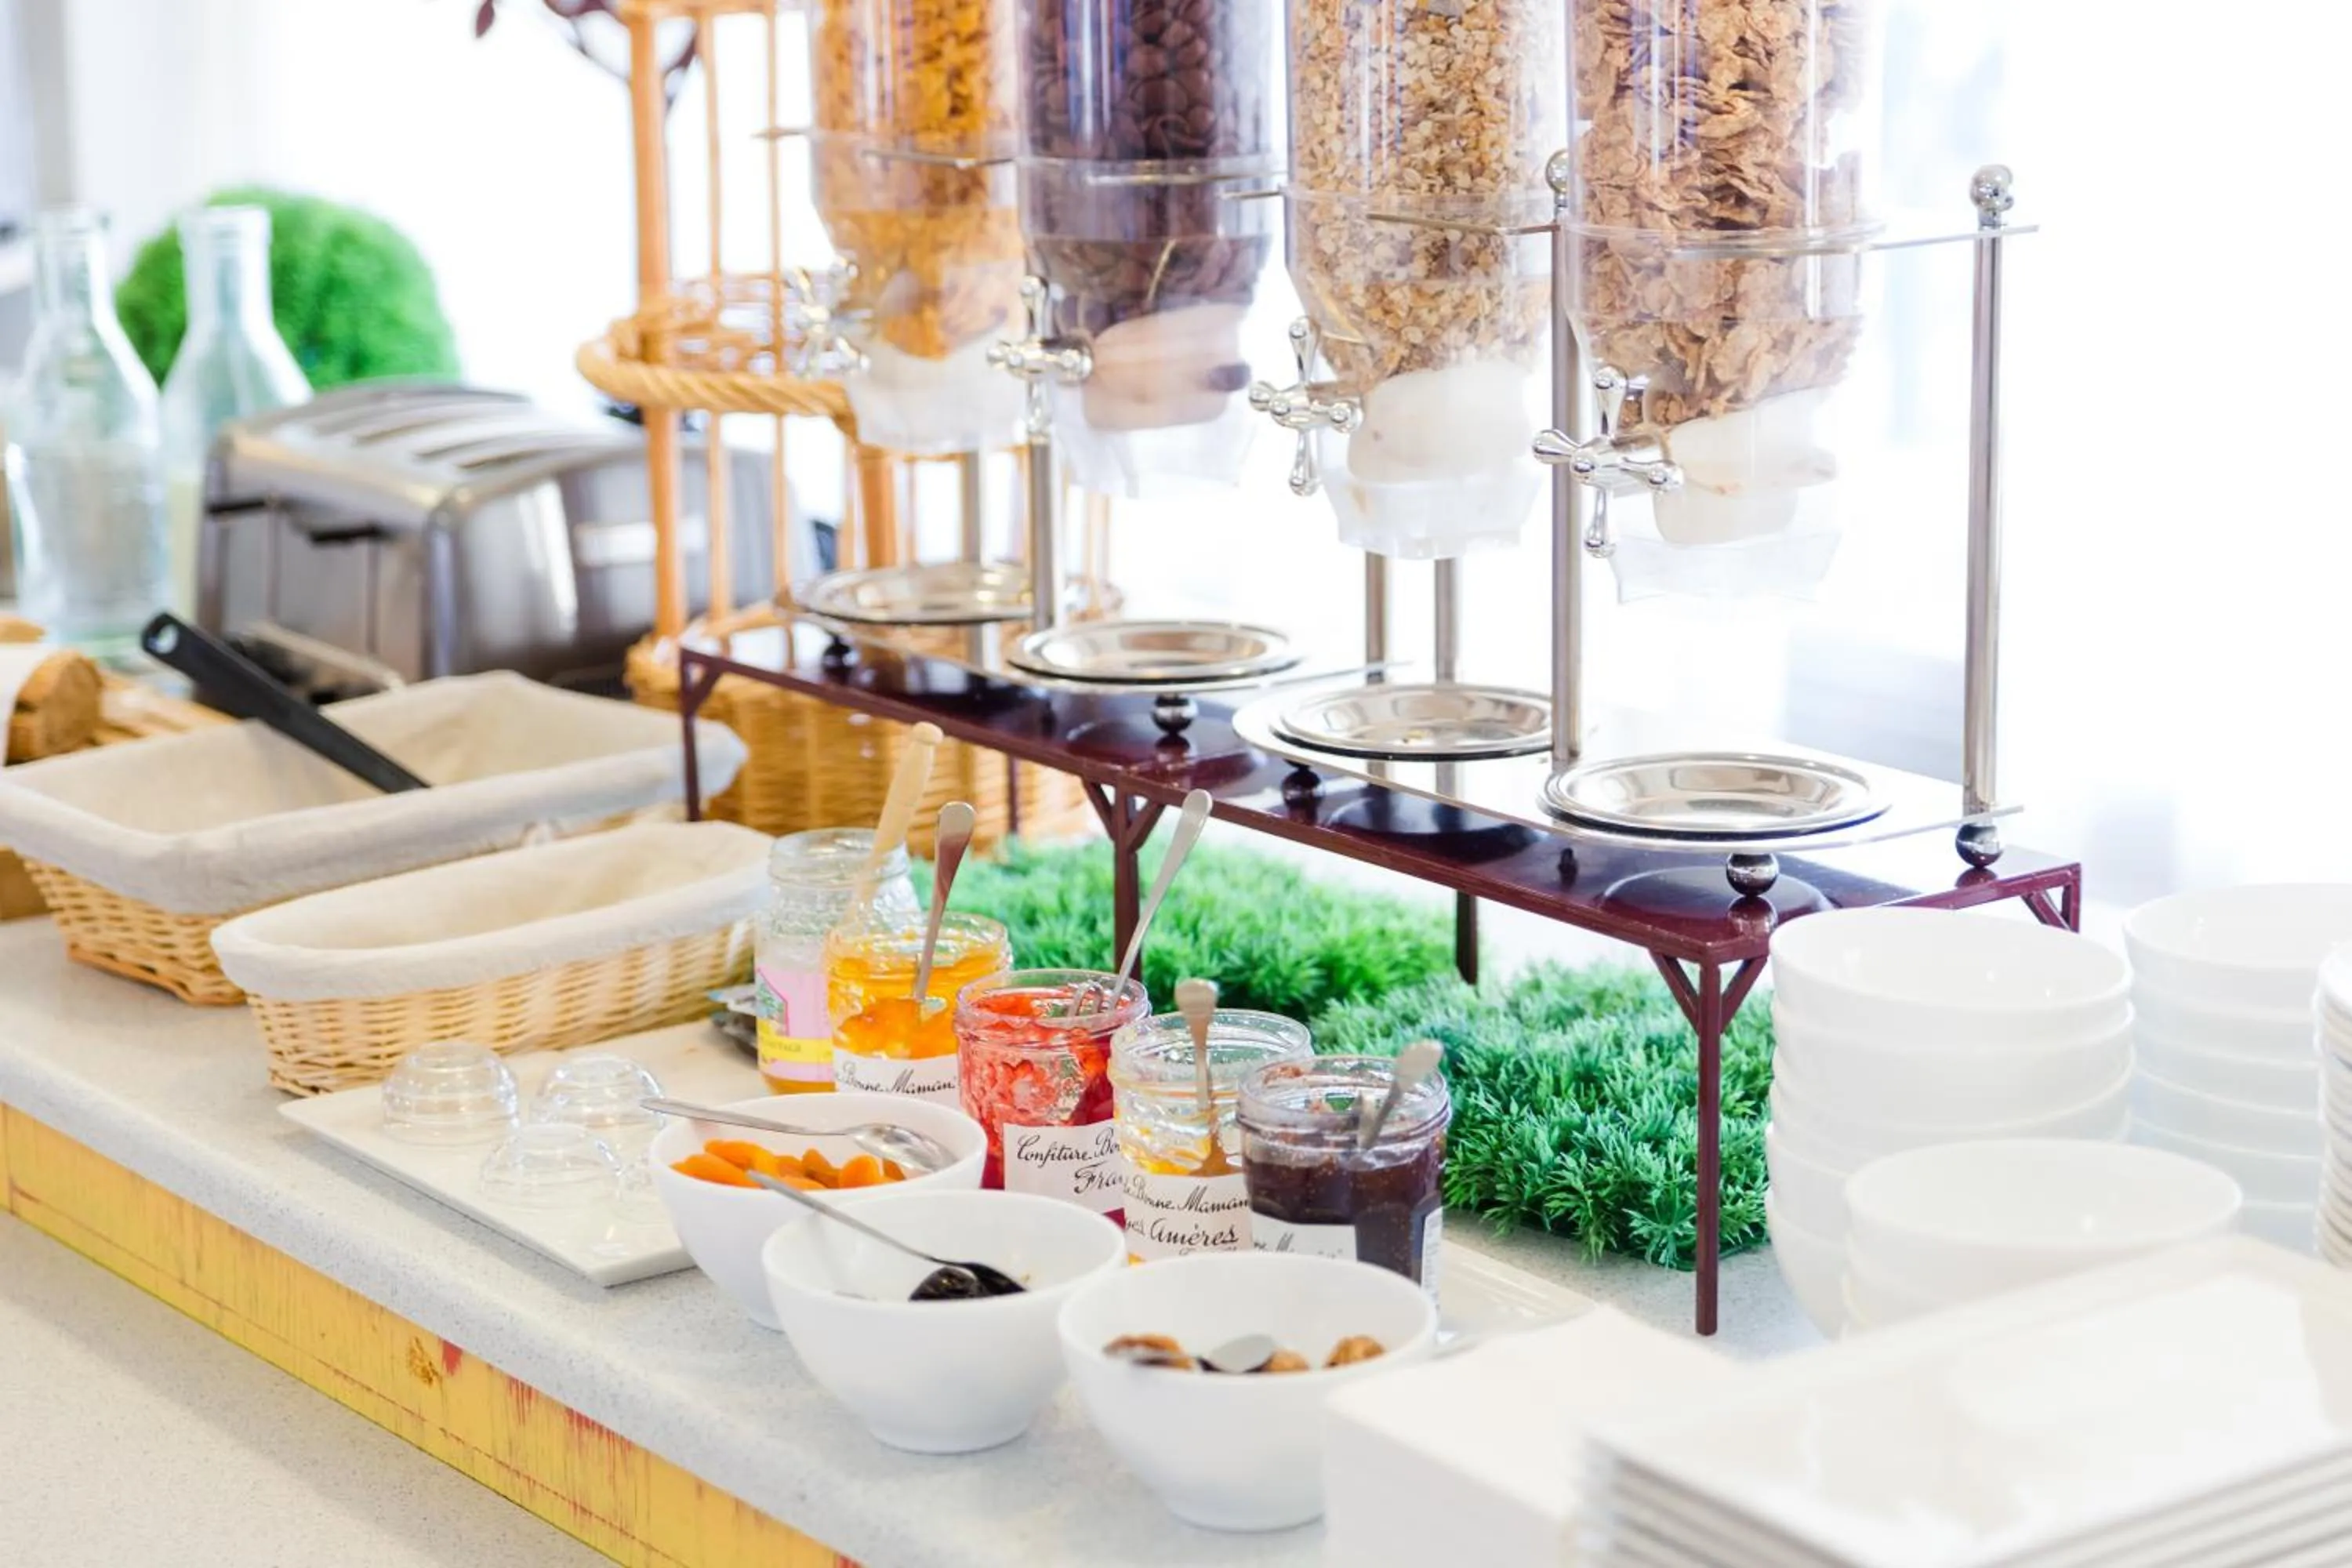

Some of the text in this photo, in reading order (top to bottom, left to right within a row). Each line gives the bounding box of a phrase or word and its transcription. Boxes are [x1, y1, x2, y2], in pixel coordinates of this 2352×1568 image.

[887, 1068, 956, 1094] Maman
[1016, 1134, 1092, 1169] Confiture
[1178, 1185, 1250, 1214] Maman
[1149, 1218, 1240, 1247] Amères
